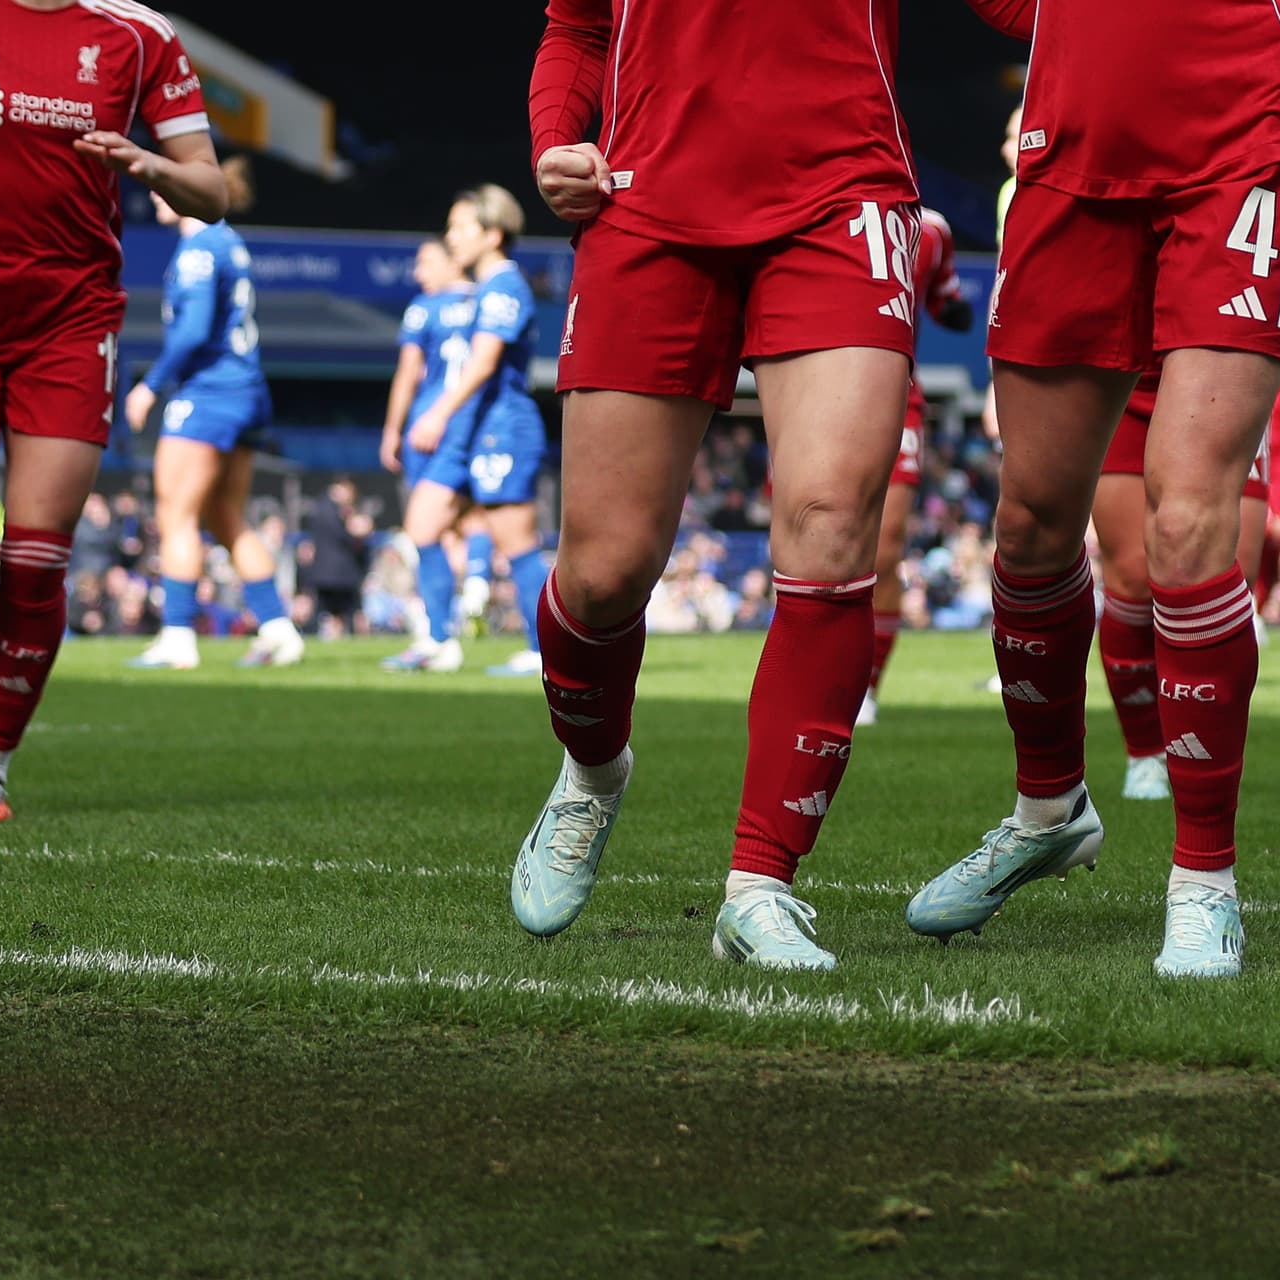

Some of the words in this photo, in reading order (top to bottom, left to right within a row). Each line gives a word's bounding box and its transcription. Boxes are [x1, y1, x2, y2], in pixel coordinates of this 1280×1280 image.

[9, 105, 97, 131] chartered
[10, 92, 93, 118] standard
[1226, 186, 1278, 278] 4
[849, 201, 913, 292] 18
[992, 624, 1048, 656] LFC
[1160, 678, 1216, 702] LFC
[794, 734, 852, 760] LFC
